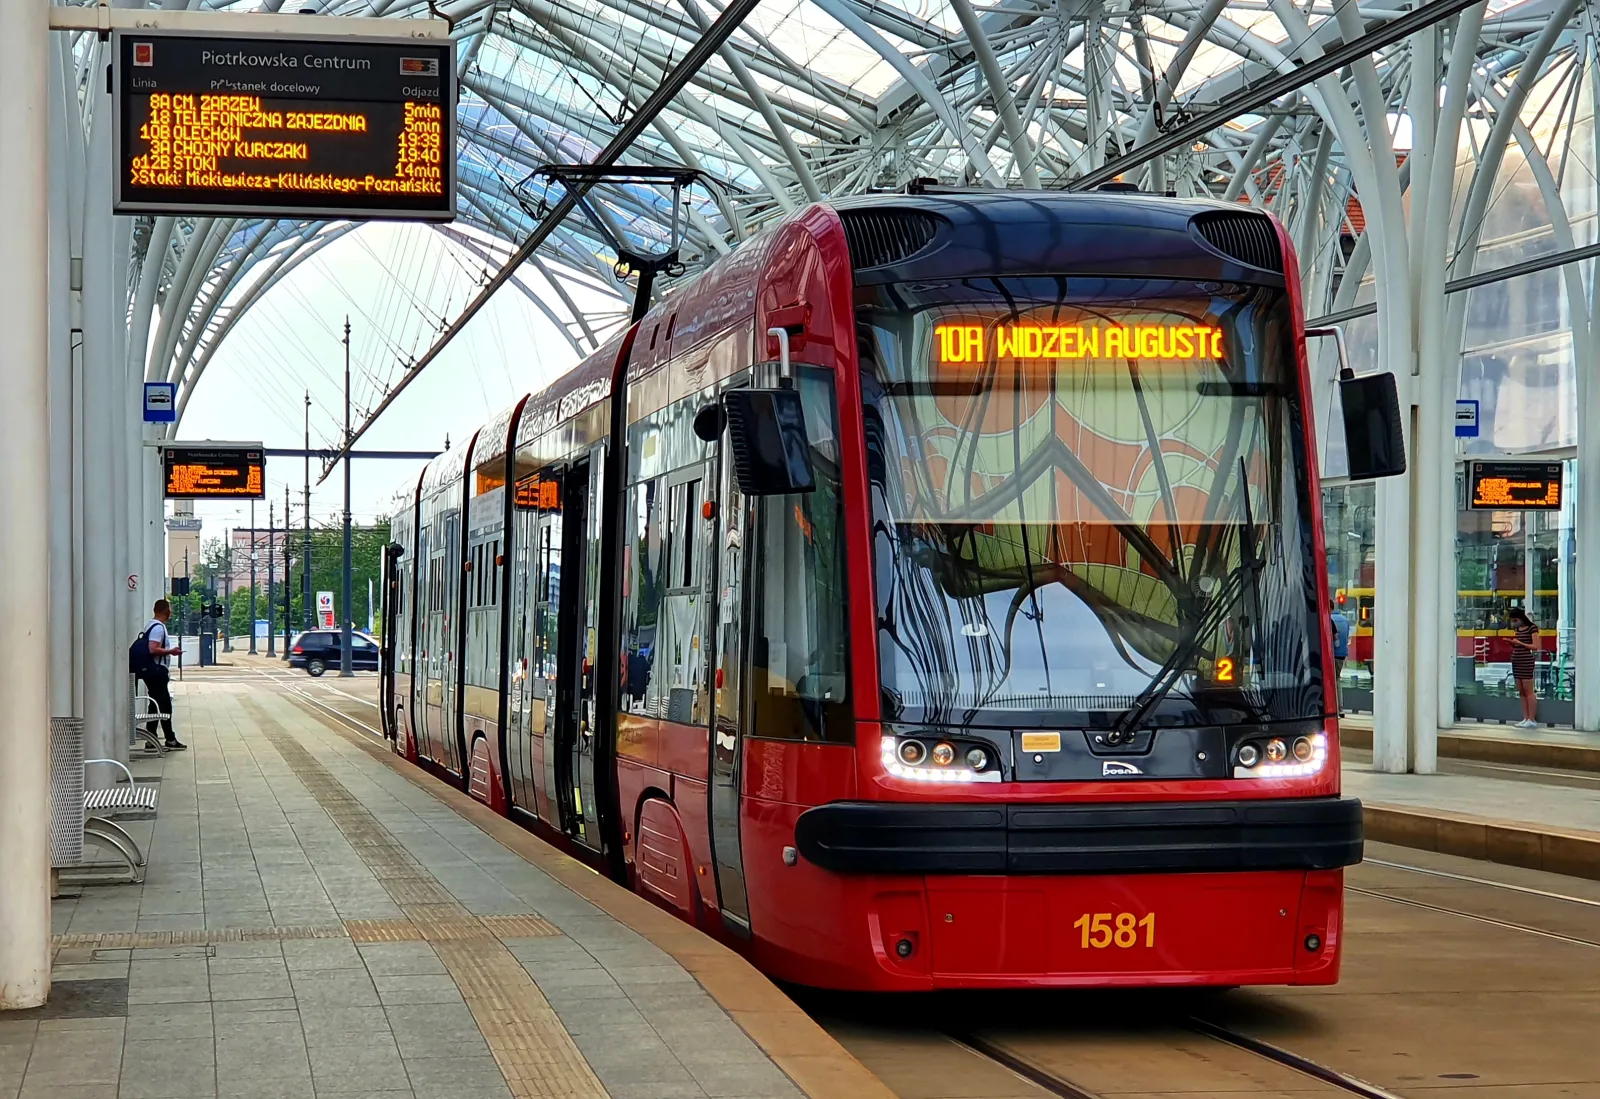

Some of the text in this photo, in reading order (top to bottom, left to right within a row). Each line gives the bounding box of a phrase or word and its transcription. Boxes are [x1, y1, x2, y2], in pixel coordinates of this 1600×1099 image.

[202, 51, 371, 69] Piotrkowska Centrum
[132, 78, 157, 88] Linia
[210, 78, 320, 95] Prstanek docelowy
[402, 87, 439, 98] Odjazd
[150, 93, 440, 118] 8A CM. ZARZEW 5min
[150, 109, 440, 133] 18 TELEFONICZNA ZAJEZDNIA 5min
[140, 124, 170, 139] 10B
[398, 132, 440, 148] 19:39
[150, 140, 440, 163] 3A CHOJNY KURCZAKI 19:40
[173, 155, 216, 171] STOKI
[395, 162, 440, 178] 14min
[935, 327, 983, 362] 10A
[997, 327, 1099, 358] WIDZEW
[1217, 659, 1232, 681] 2
[1073, 912, 1155, 948] 1581
